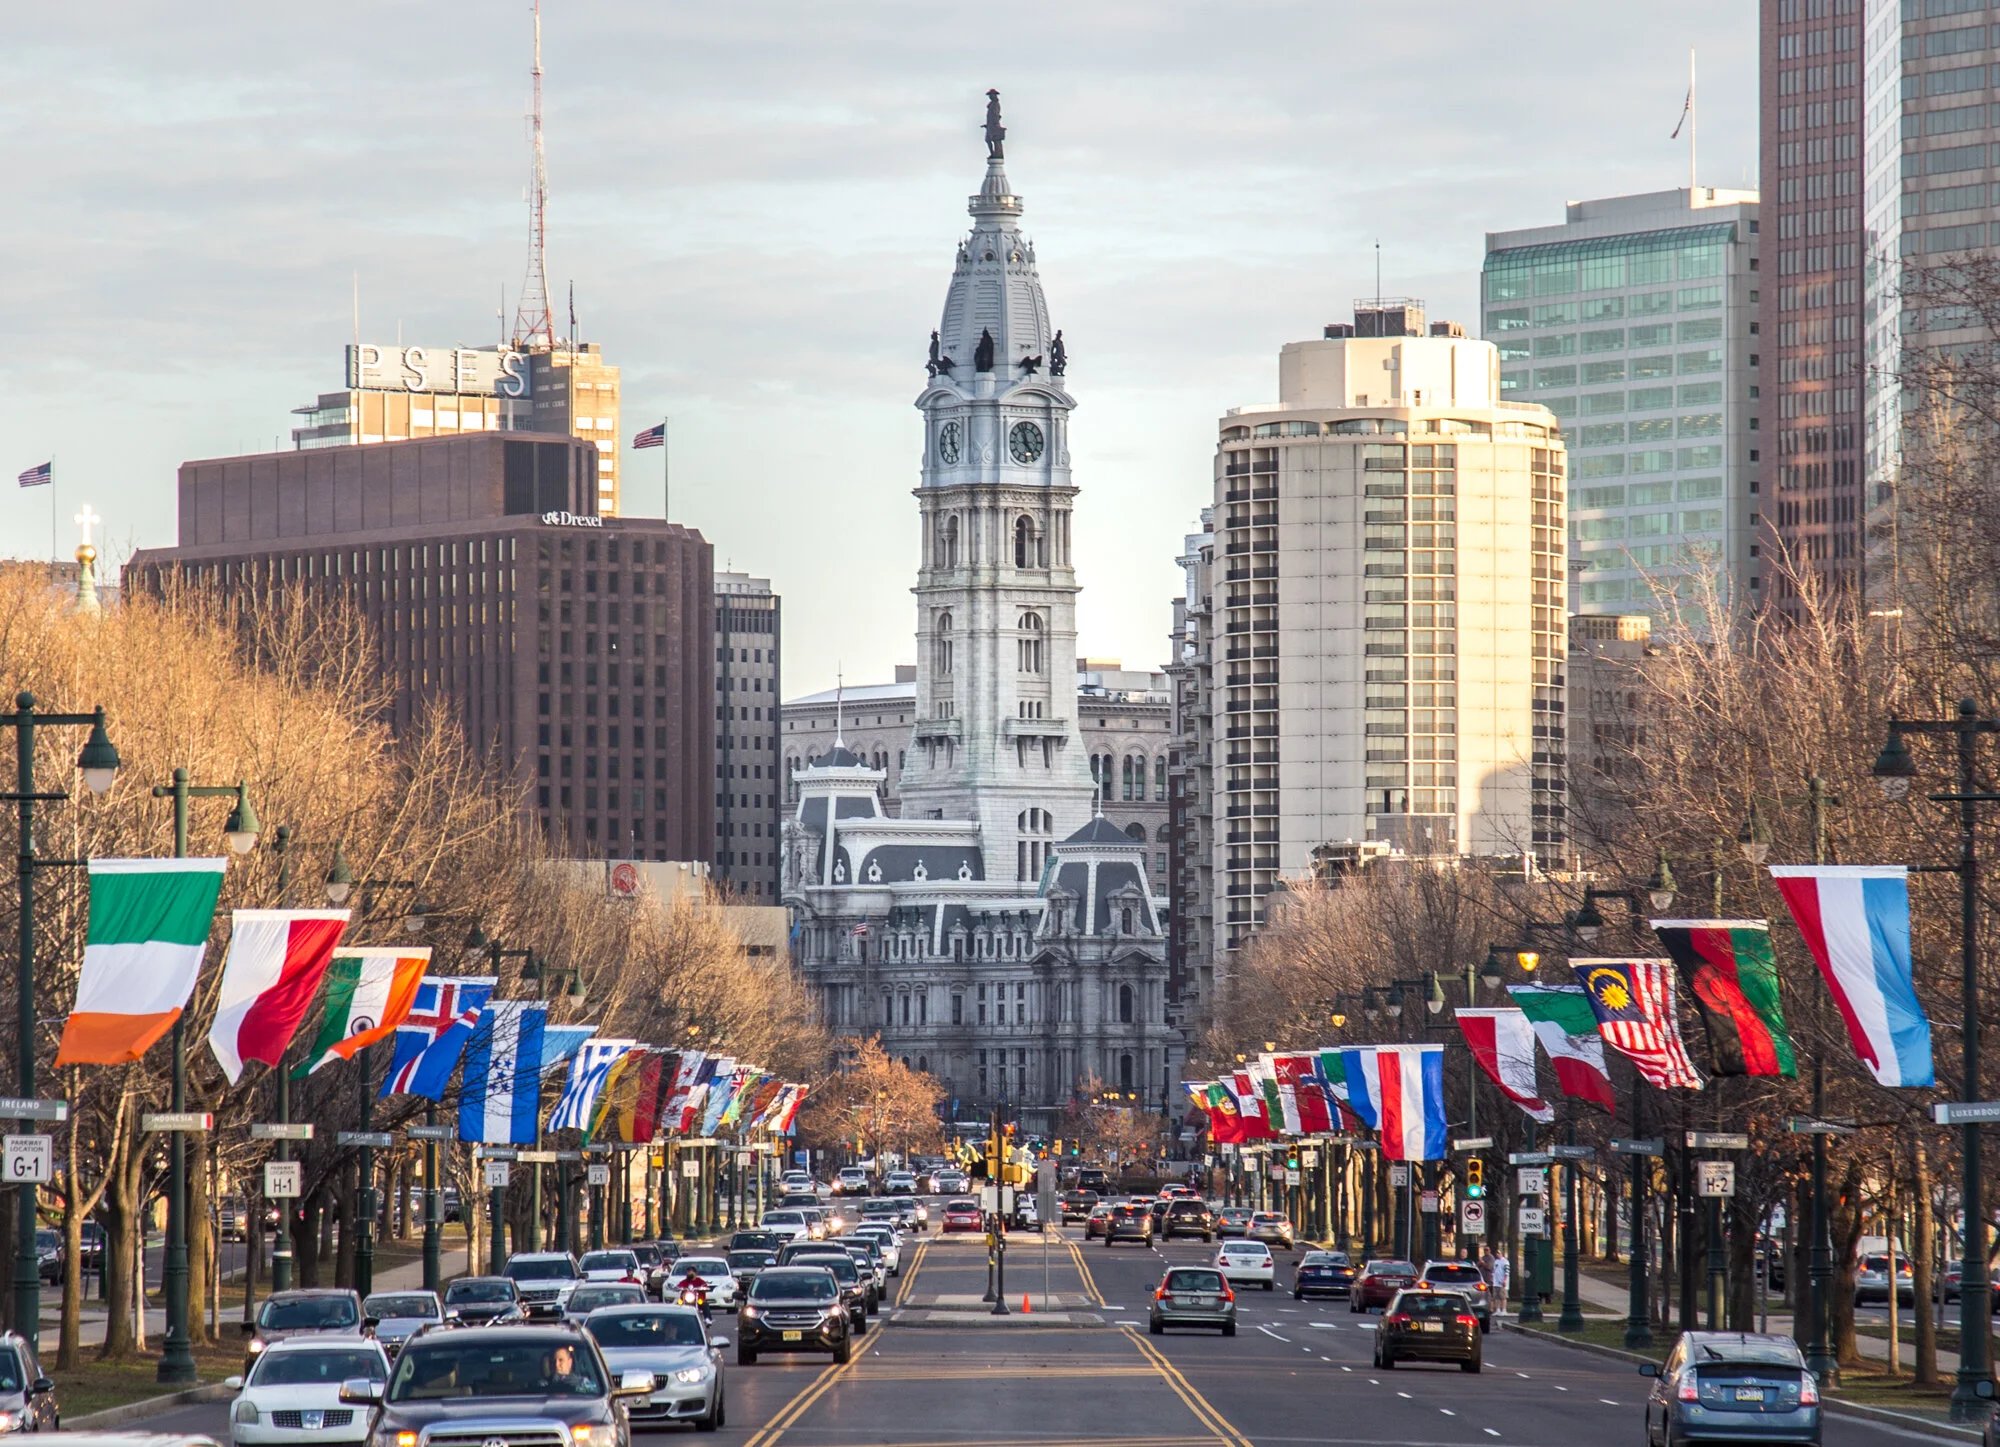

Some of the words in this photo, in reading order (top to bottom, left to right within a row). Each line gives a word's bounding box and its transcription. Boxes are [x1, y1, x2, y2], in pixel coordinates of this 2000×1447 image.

[358, 344, 524, 396] PSFS
[560, 511, 602, 526] Drexel
[1, 1100, 40, 1109] IRELAND
[14, 1156, 39, 1177] G-1
[273, 1178, 292, 1193] H-1
[593, 1173, 603, 1183] J-1
[1395, 1175, 1406, 1185] J-2
[1706, 1177, 1728, 1193] H-2
[1525, 1212, 1537, 1220] NO
